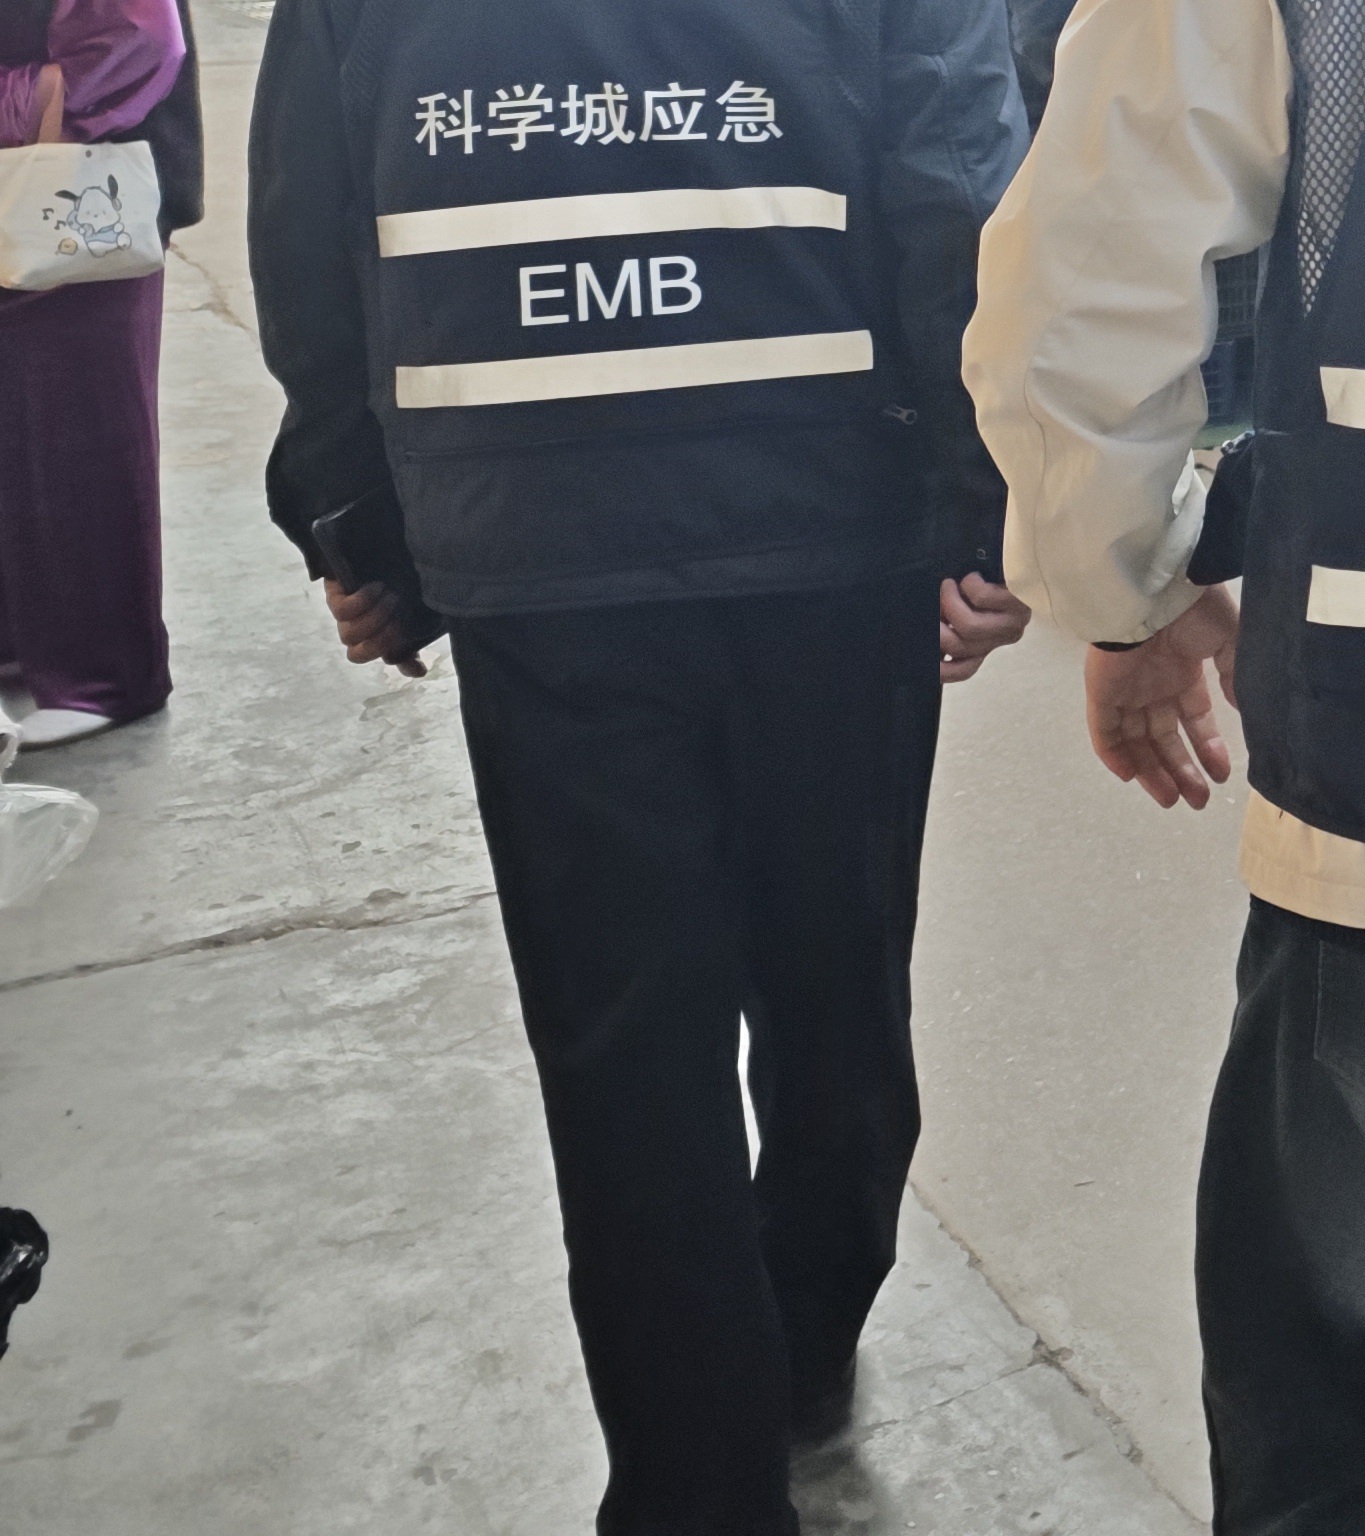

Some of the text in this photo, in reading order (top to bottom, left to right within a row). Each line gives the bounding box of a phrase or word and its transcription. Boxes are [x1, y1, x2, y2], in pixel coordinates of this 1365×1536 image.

[414, 80, 783, 156] 科学城应急
[519, 255, 702, 327] EMB
